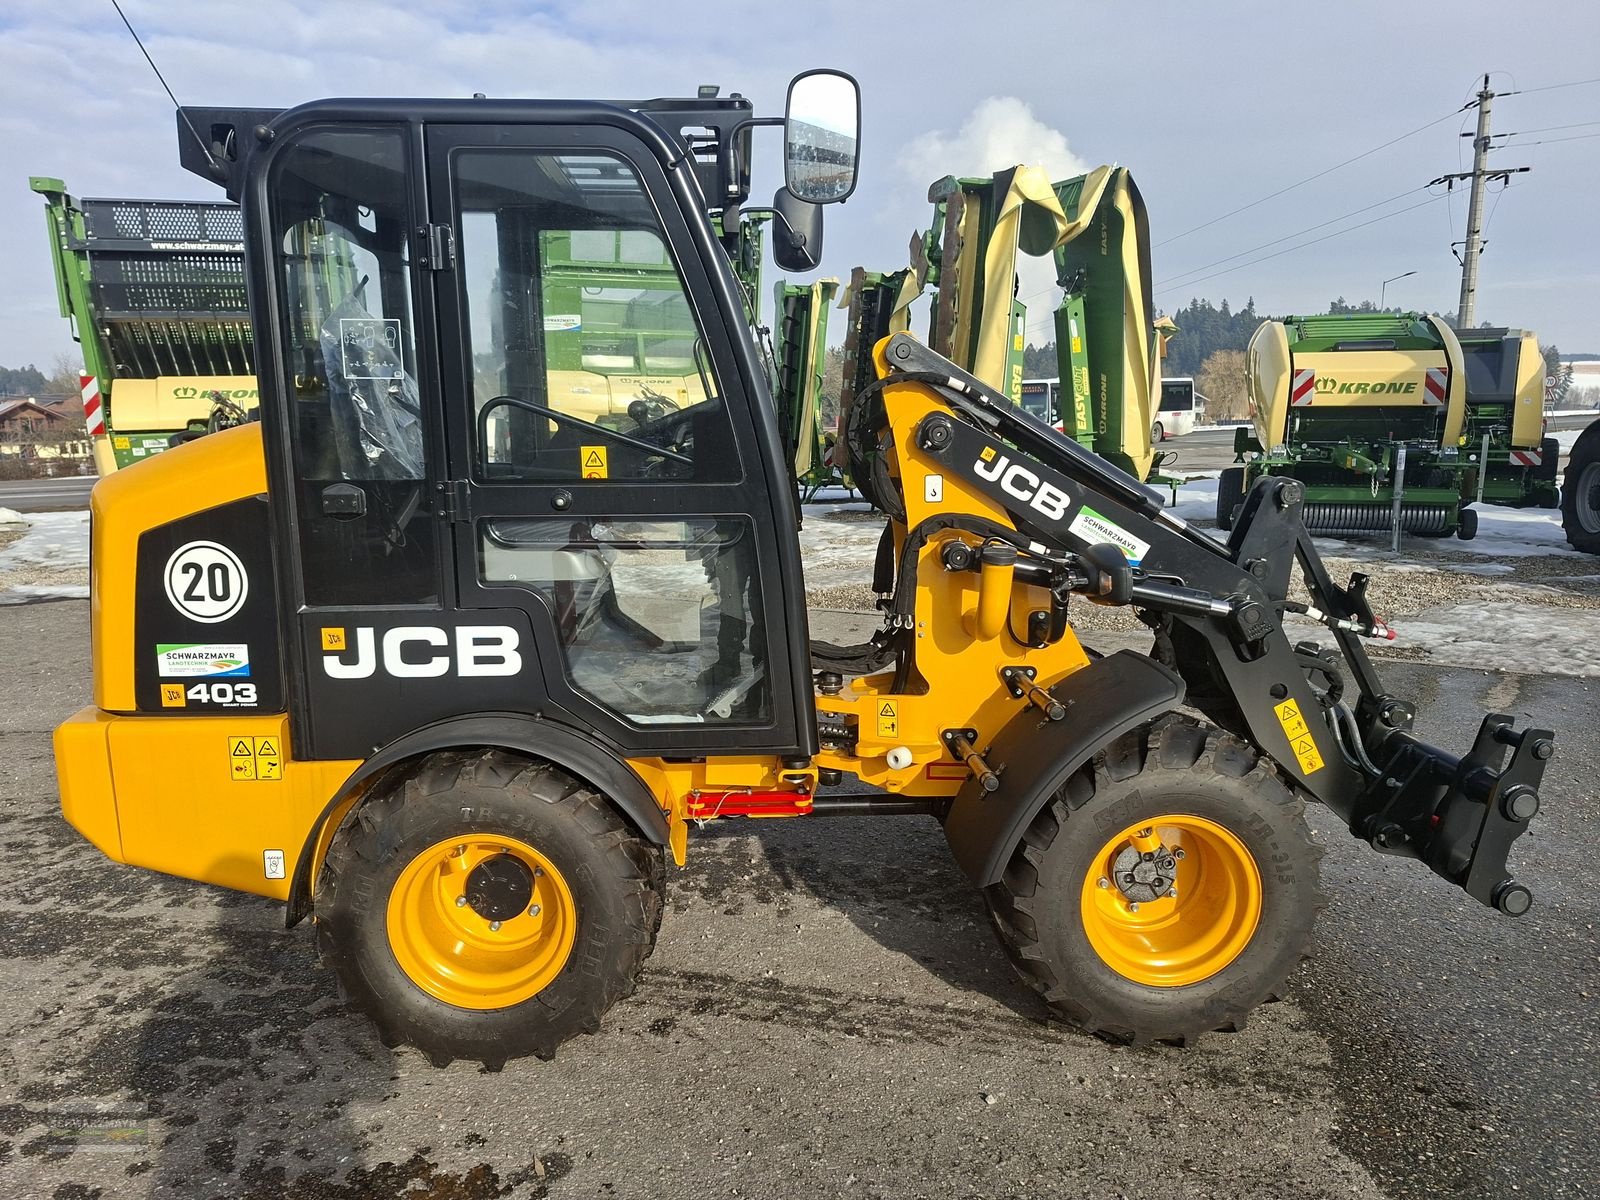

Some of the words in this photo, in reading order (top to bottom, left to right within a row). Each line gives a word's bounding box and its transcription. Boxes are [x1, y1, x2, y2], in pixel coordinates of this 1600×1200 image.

[1337, 382, 1418, 394] KRONE
[973, 455, 1071, 521] JCB
[1083, 516, 1137, 551] SCHWARZMAYR
[181, 562, 231, 602] 20
[166, 652, 235, 660] SCHWARZMAYR
[323, 626, 523, 679] JCB
[186, 683, 258, 703] 403
